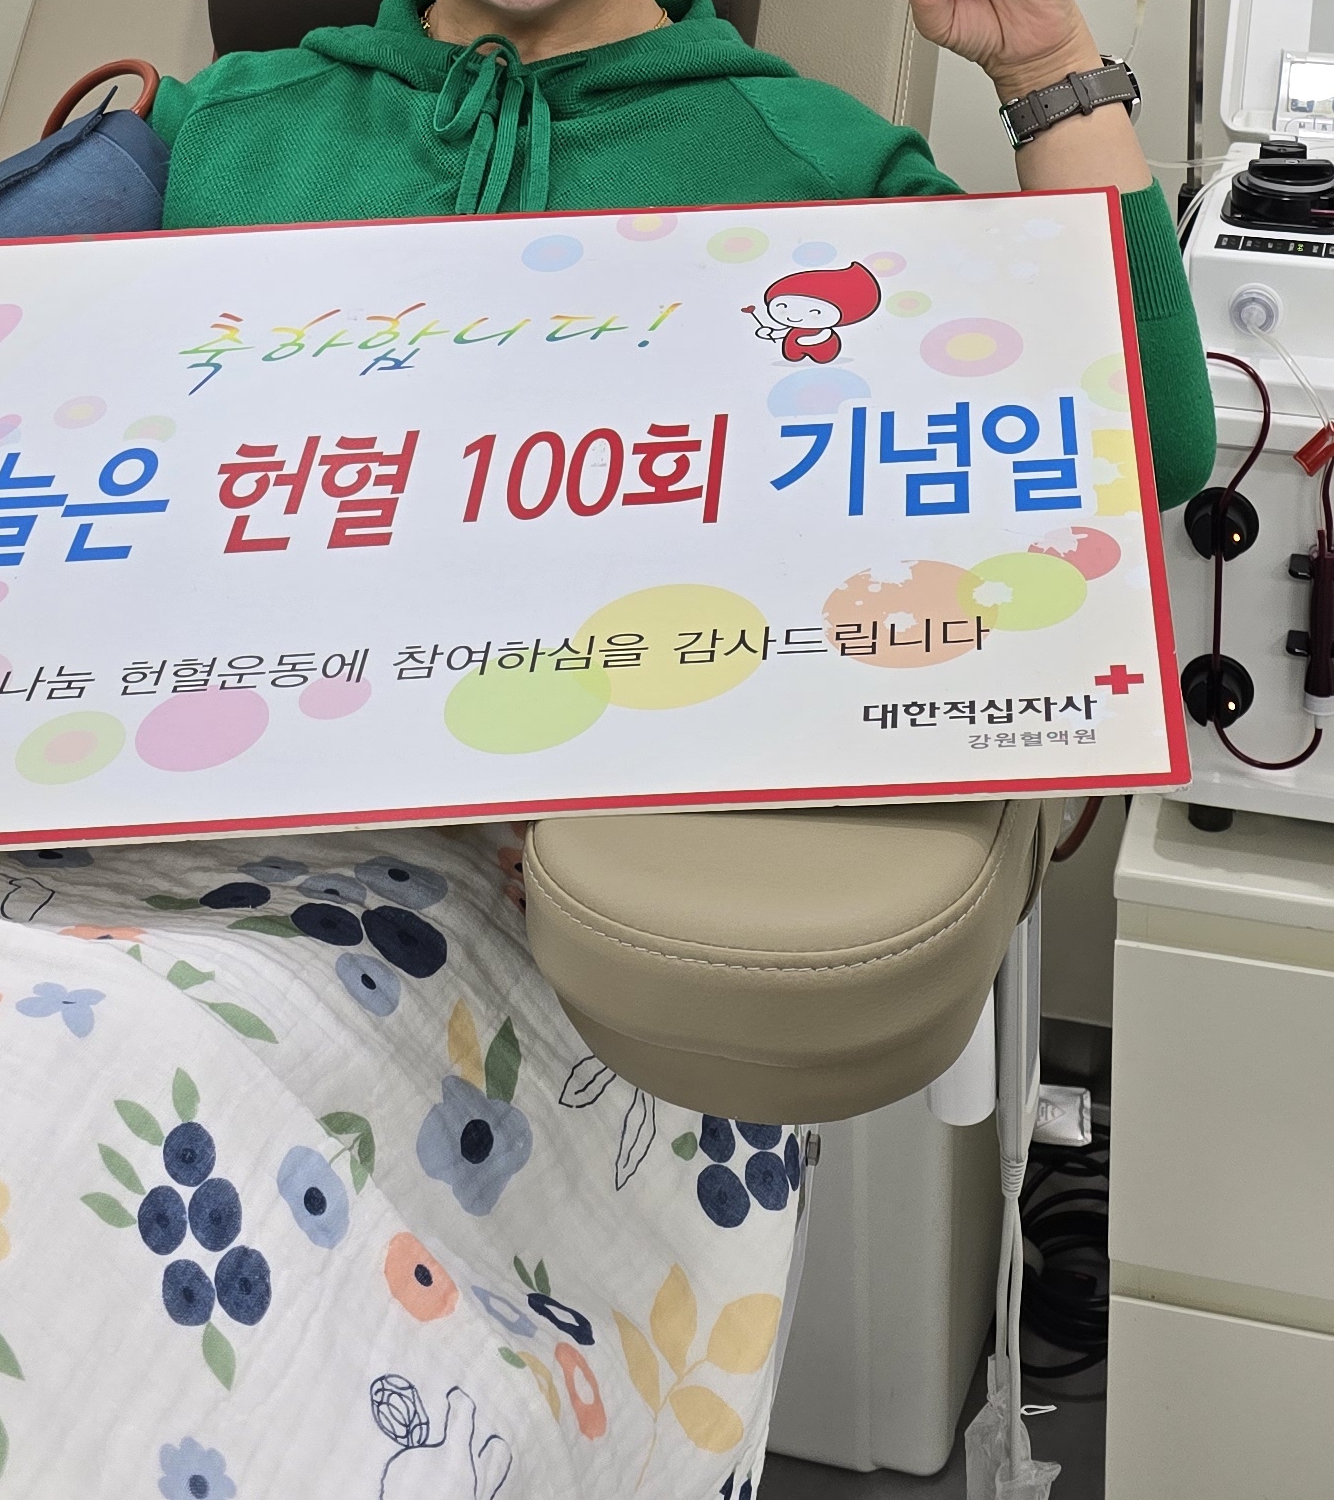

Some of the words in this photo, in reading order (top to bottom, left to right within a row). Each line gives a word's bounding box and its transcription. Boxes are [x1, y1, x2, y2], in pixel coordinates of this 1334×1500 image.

[179, 302, 684, 397] 축하합니다!
[217, 429, 421, 555] 헌혈
[462, 413, 729, 524] 100회
[769, 395, 1083, 518] 기념일
[120, 648, 370, 697] 헌혈운동에
[392, 631, 650, 682] 참여하심을
[671, 615, 991, 666] 감사드립니다
[862, 694, 1098, 730] 대한적십자사
[967, 728, 1098, 751] 강원혈액원
